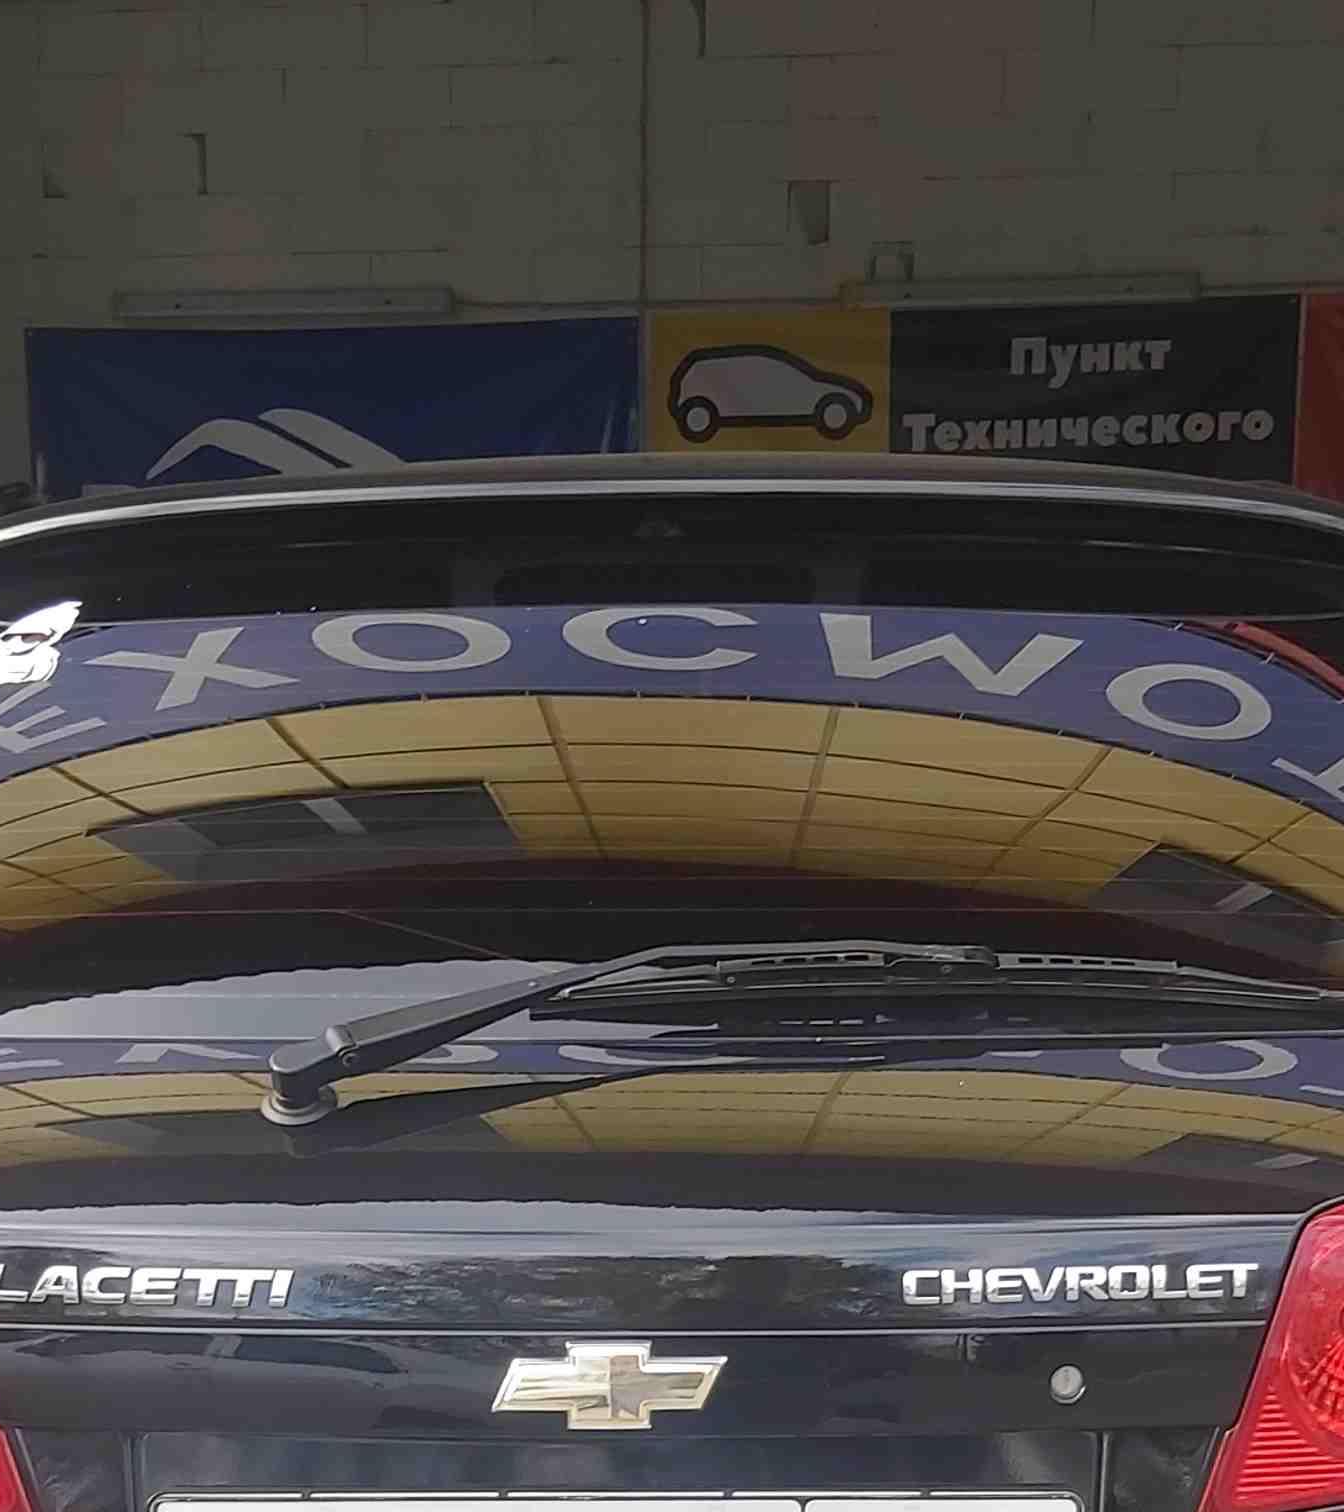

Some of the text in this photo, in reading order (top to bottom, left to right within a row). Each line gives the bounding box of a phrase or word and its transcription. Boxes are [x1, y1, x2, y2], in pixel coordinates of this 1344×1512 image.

[1010, 336, 1172, 388] Пункт
[903, 410, 1274, 452] Технического
[901, 1262, 1260, 1306] CHEVROLET
